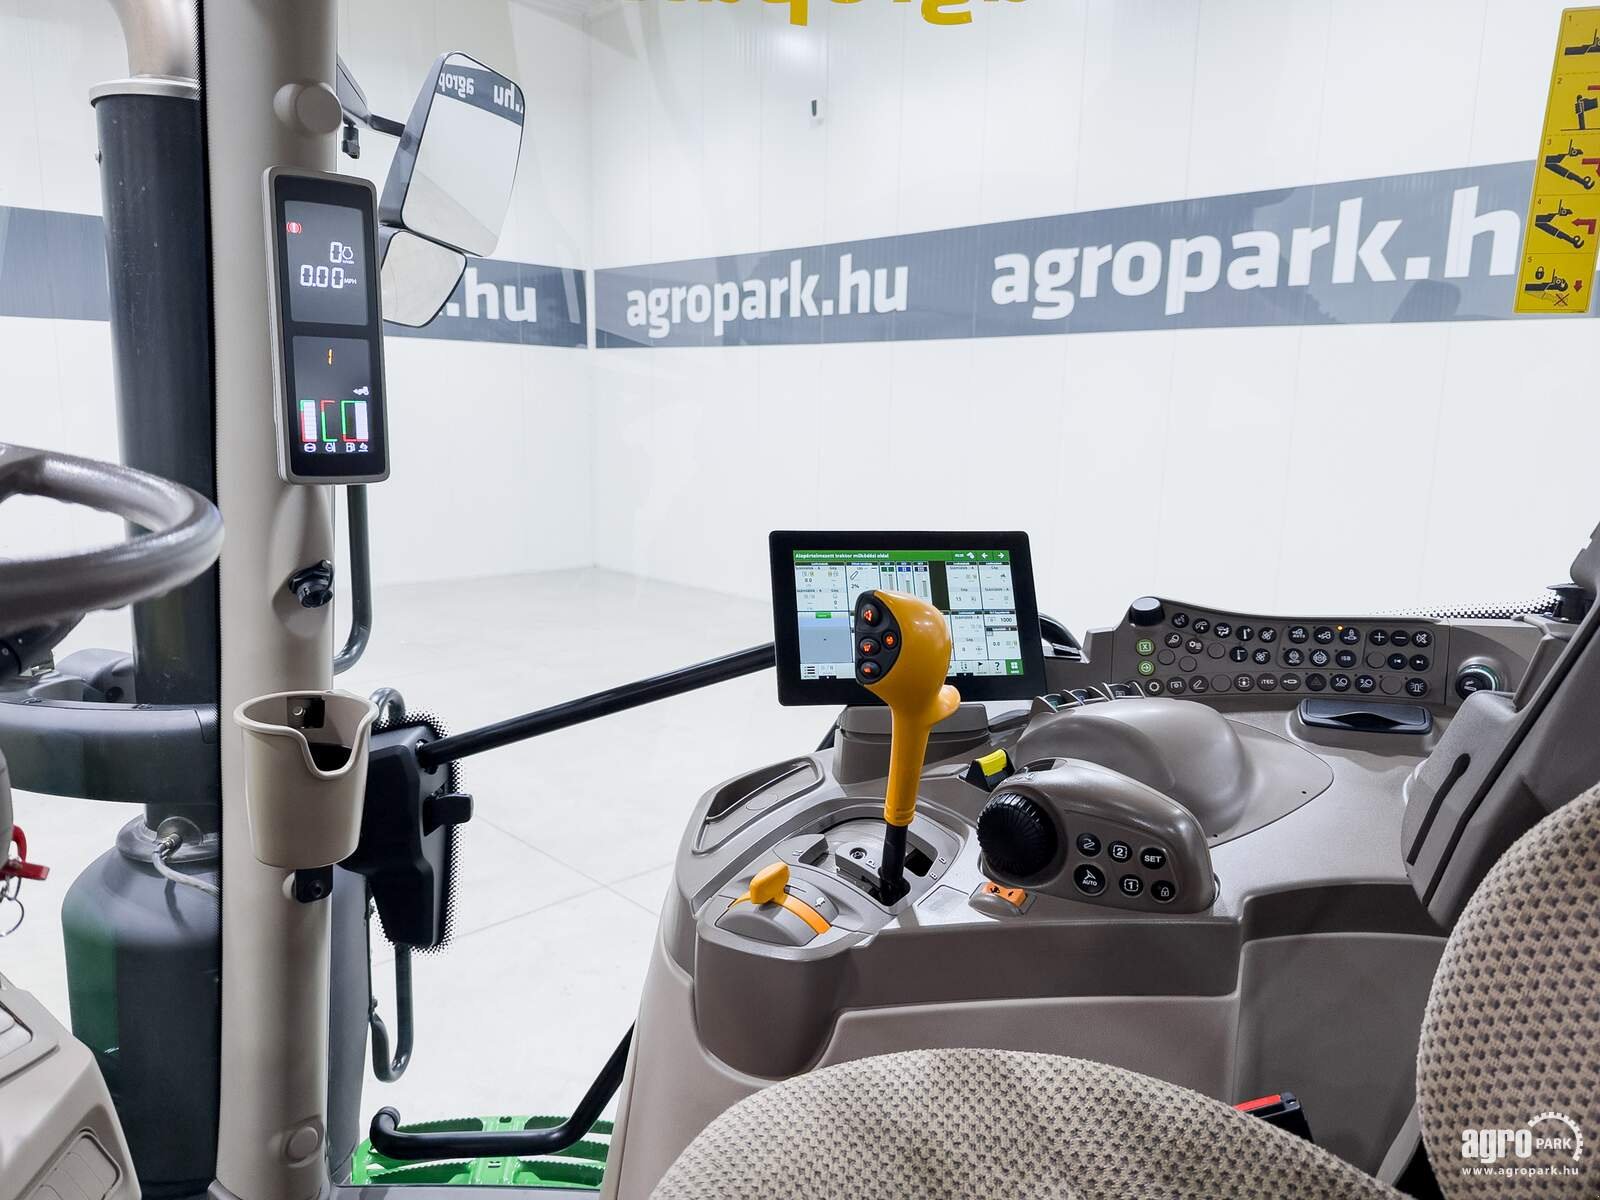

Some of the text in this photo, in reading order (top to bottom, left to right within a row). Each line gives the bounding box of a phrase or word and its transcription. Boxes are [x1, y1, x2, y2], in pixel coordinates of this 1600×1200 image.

[330, 241, 343, 264] 0
[991, 185, 1523, 321] agropark.h
[300, 264, 357, 289] 0.00 MPH
[626, 253, 909, 339] agropark.hu
[1144, 855, 1162, 863] SET
[1082, 879, 1098, 887] AUTO
